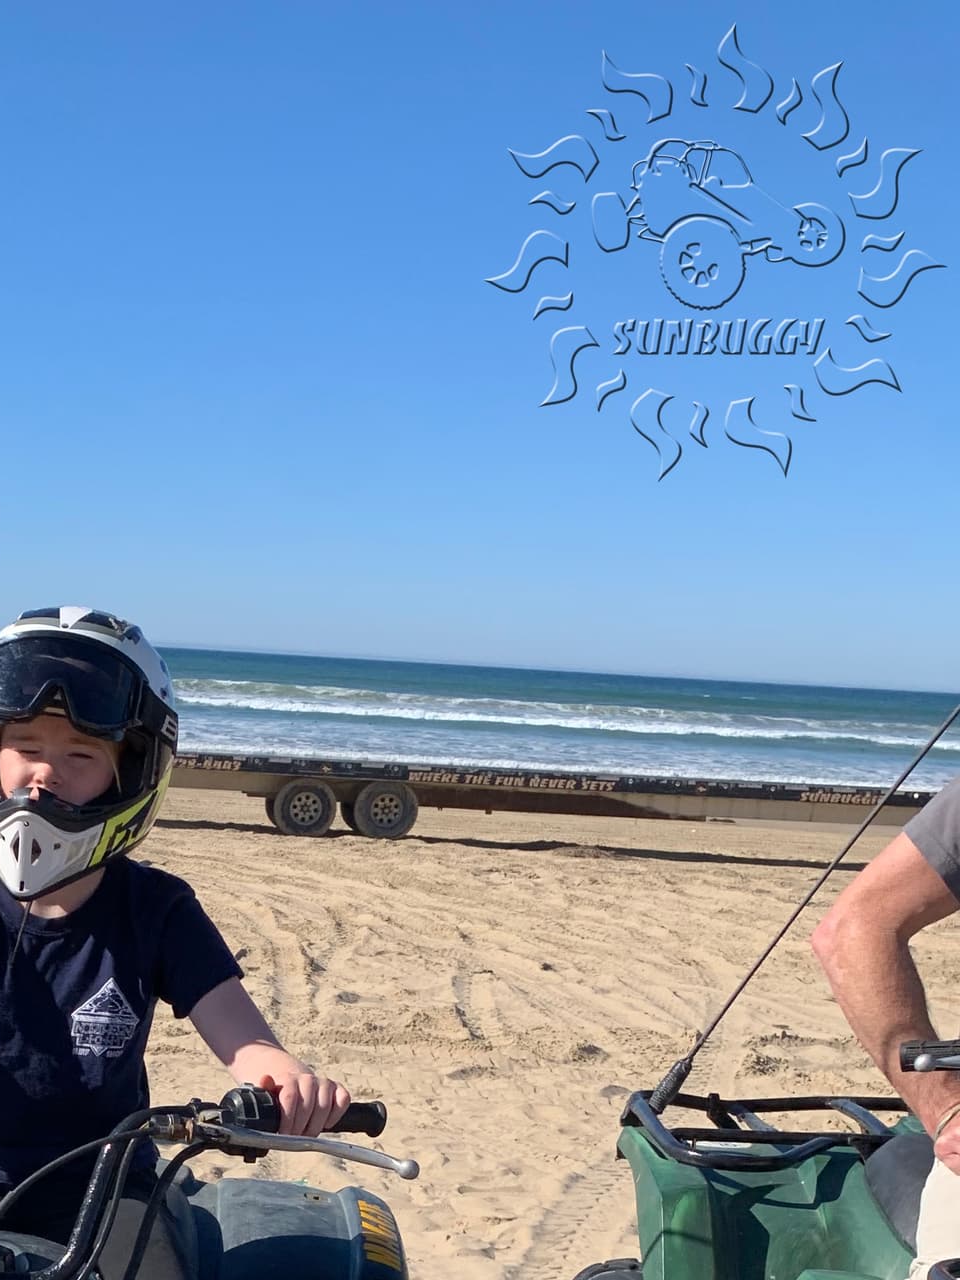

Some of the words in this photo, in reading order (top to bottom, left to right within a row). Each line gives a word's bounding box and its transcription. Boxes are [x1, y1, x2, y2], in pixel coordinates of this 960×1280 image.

[408, 771, 460, 784] WHERE
[464, 773, 491, 785] THE
[494, 775, 525, 786] FUN
[529, 775, 577, 790] NEVER
[581, 777, 616, 791] SETS
